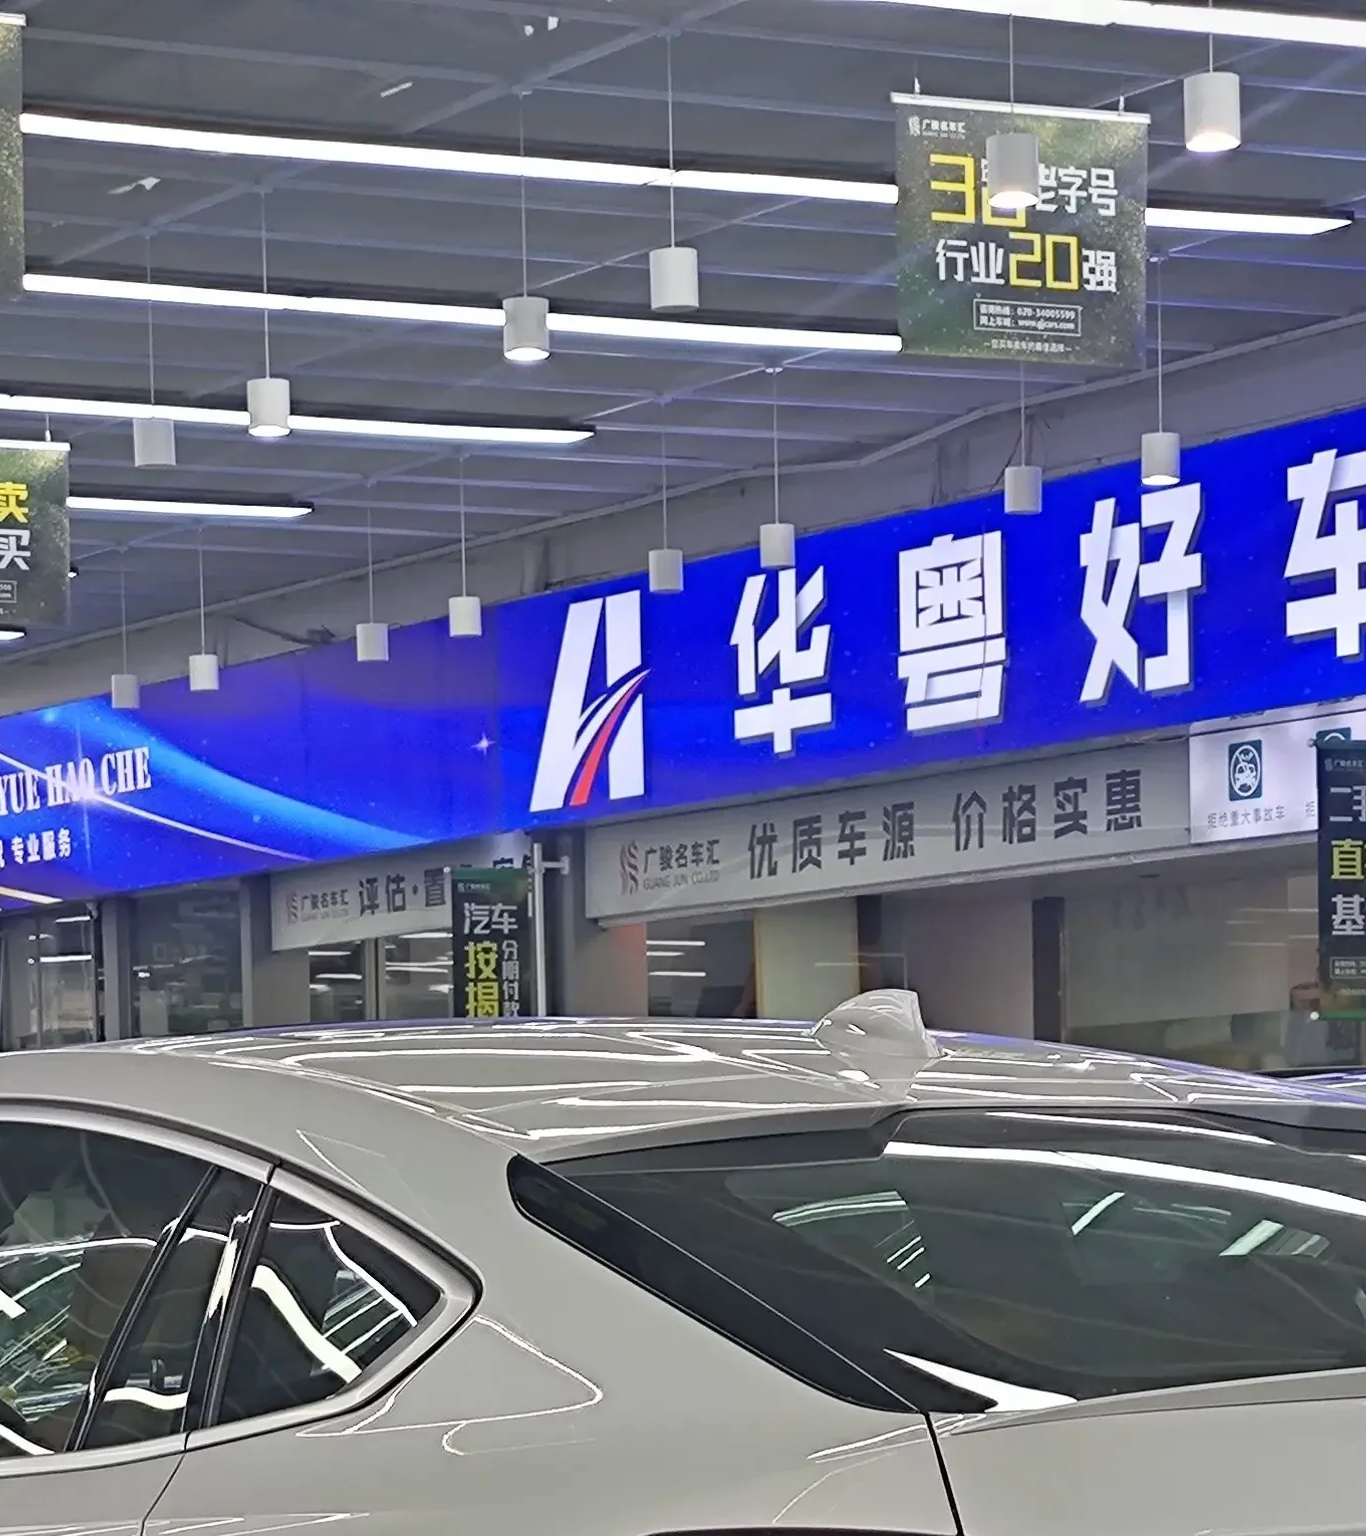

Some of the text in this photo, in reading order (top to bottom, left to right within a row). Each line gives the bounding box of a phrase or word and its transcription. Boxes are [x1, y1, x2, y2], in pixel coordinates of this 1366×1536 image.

[935, 231, 1119, 294] 行业20强
[45, 757, 96, 808] HAO
[100, 746, 152, 796] CHE
[11, 827, 72, 865] 专业服务
[747, 769, 1143, 880] 优质车源 价格实惠
[464, 902, 519, 935] 汽车
[464, 940, 500, 1018] 按揭
